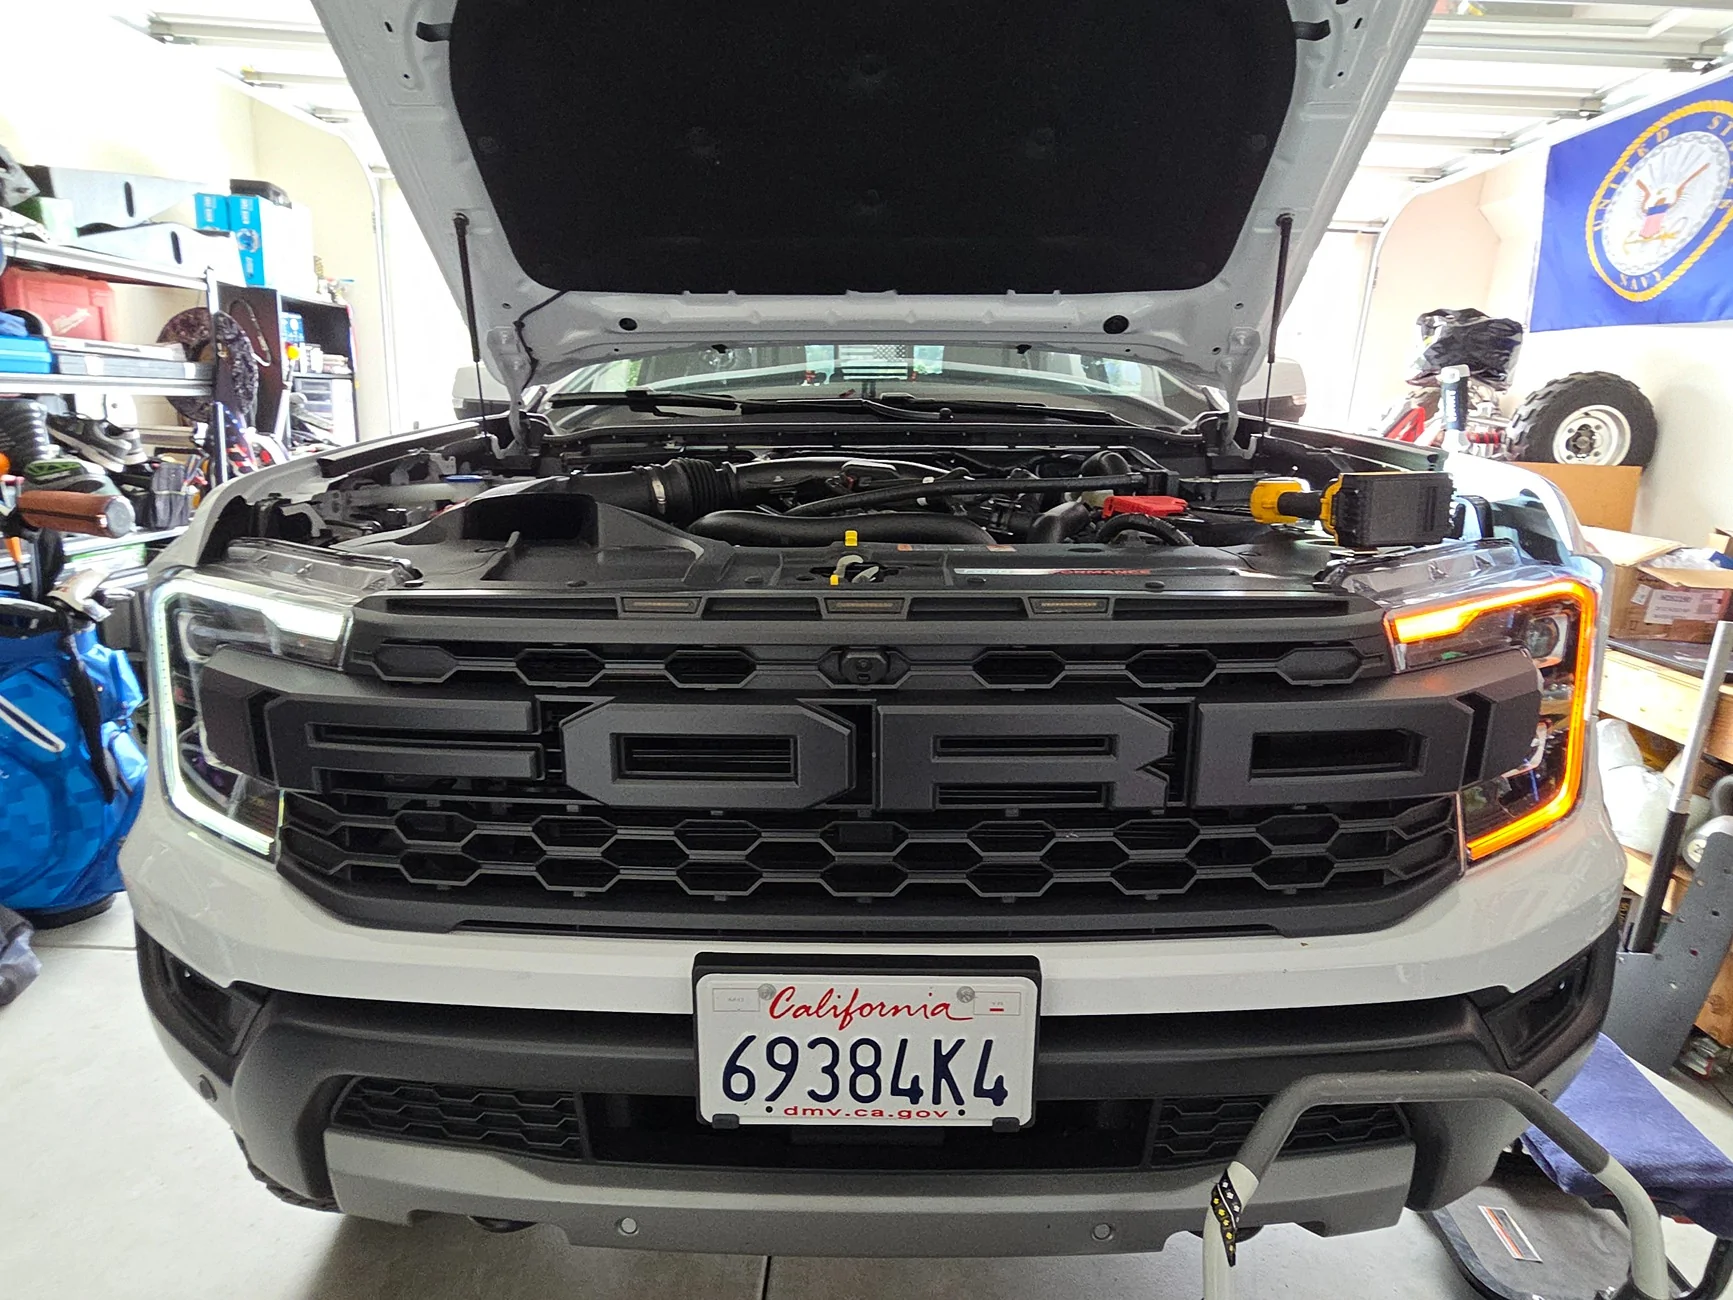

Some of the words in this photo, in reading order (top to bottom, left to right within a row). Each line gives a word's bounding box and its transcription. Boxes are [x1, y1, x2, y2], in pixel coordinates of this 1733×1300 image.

[1619, 267, 1664, 291] NAVY
[268, 696, 1475, 811] FORD
[769, 986, 974, 1031] California
[722, 1034, 1008, 1107] 69384K4
[783, 1105, 949, 1120] dmv.ca.gov
